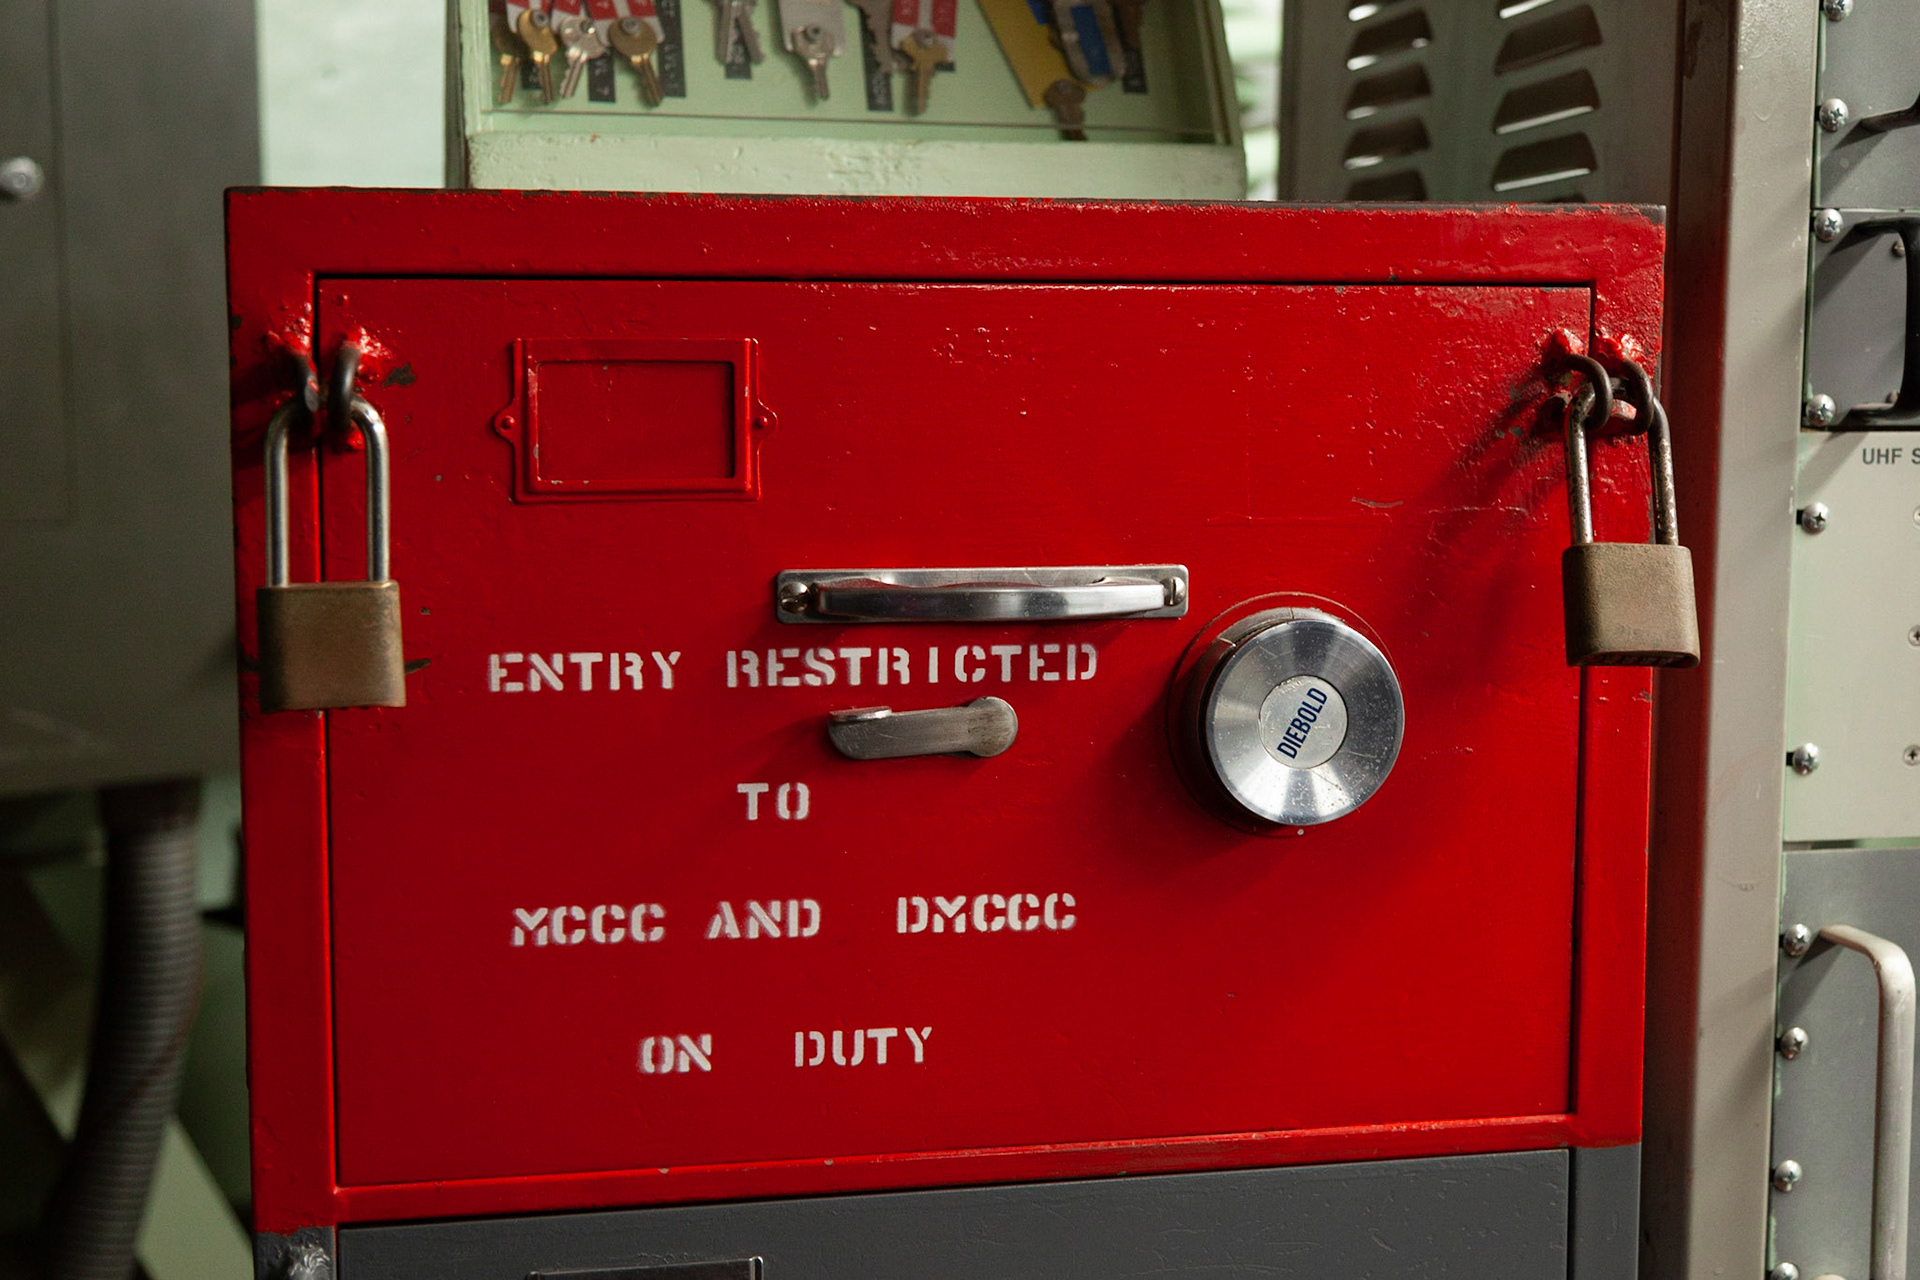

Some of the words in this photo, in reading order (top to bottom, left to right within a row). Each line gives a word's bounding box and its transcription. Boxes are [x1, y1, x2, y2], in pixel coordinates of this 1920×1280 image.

[1862, 447, 1903, 465] UHF
[489, 651, 681, 692] ENTRY
[727, 644, 1097, 688] RESTRICTED
[1276, 687, 1328, 760] DIEBOLD
[737, 782, 811, 821] TO
[511, 903, 666, 946] MCCC
[706, 899, 822, 939] AND
[897, 892, 1077, 934] DMCCC
[639, 1033, 713, 1074] ON
[795, 1026, 933, 1067] DUTY
